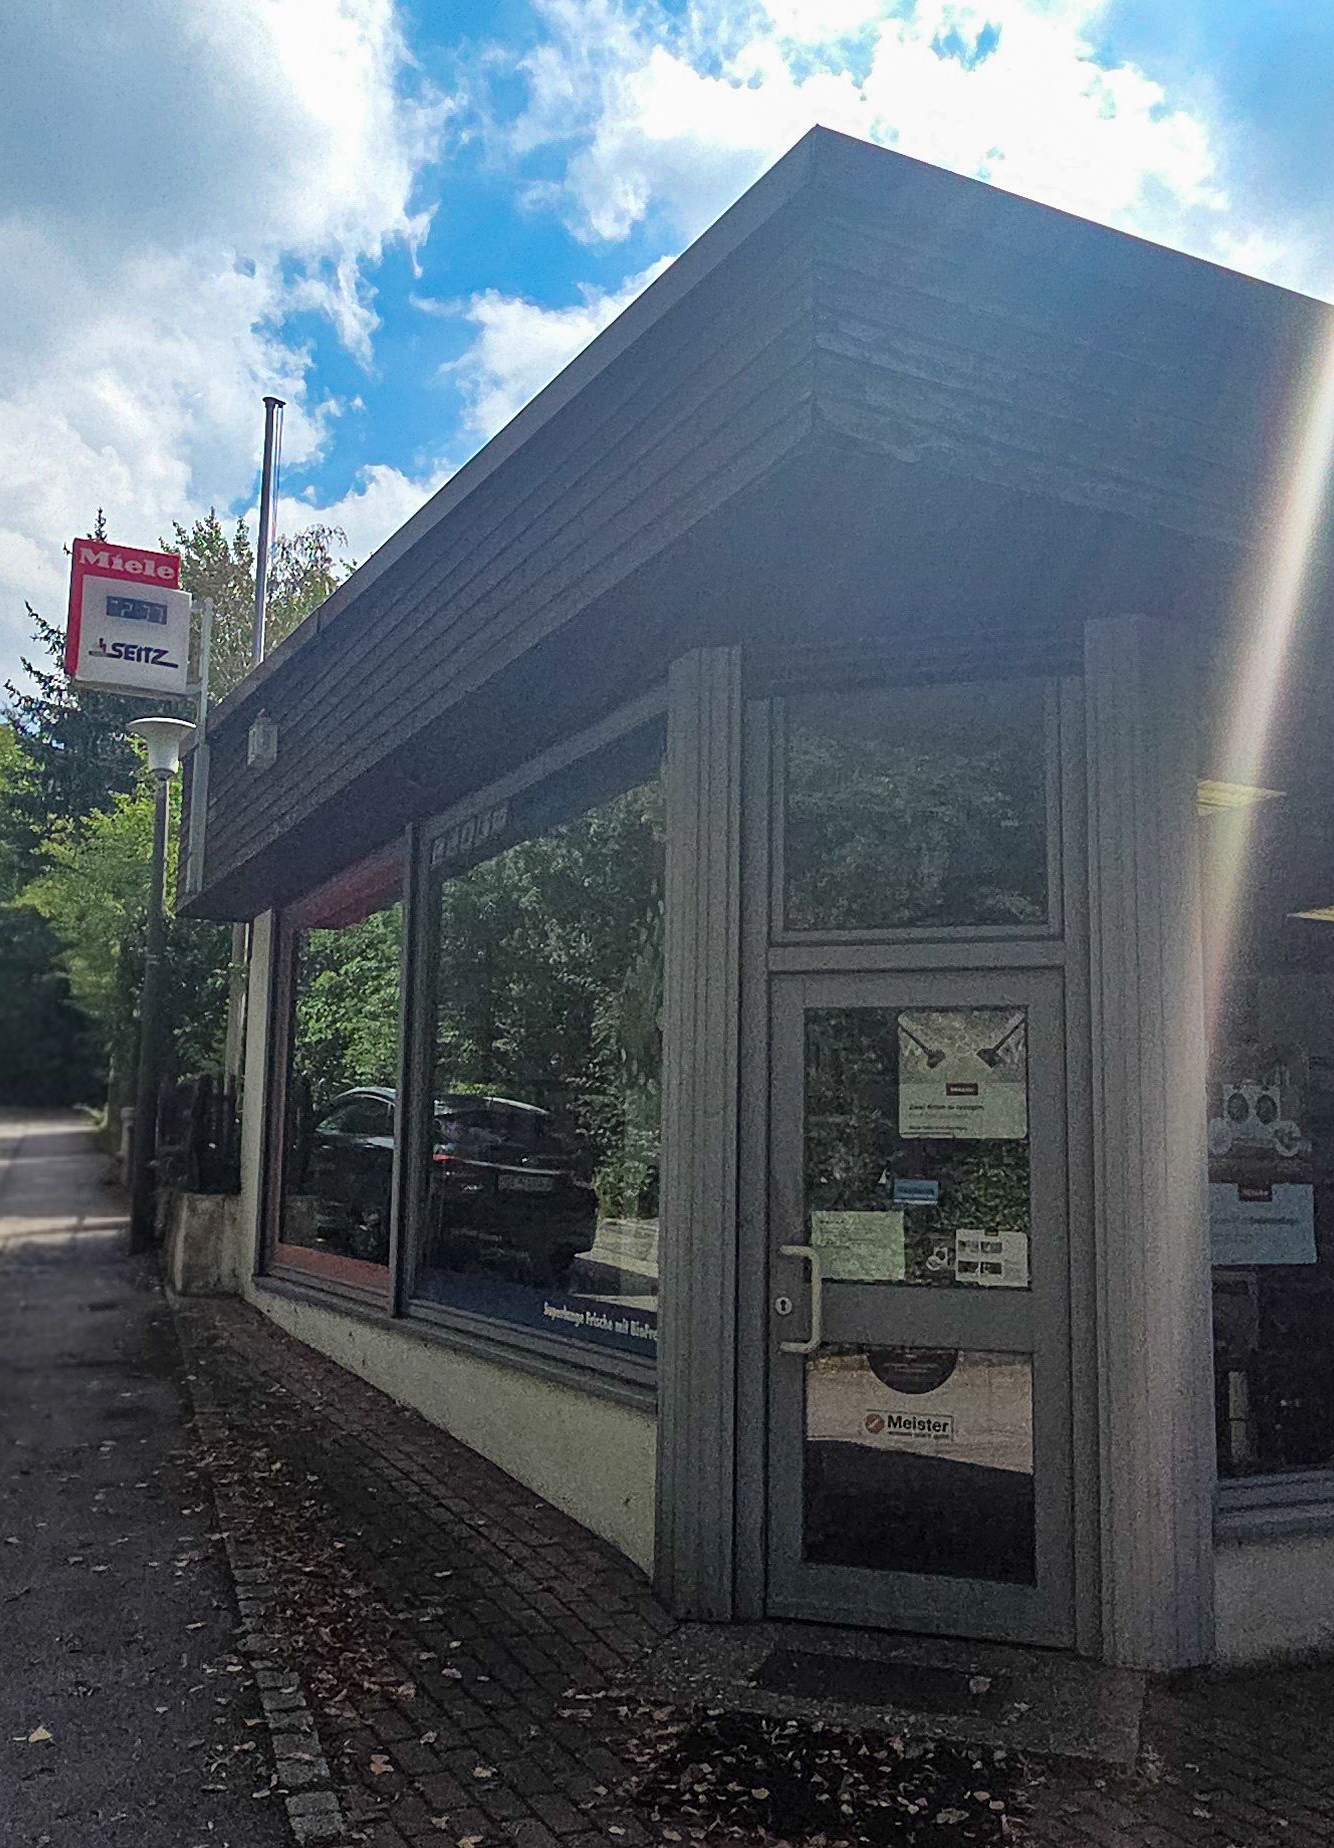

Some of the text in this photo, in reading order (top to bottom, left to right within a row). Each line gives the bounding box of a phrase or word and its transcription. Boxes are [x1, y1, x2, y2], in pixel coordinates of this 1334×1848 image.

[78, 549, 175, 579] Miele
[110, 642, 173, 667] SEITZ
[614, 1318, 629, 1335] mit
[887, 1416, 949, 1435] Meister
